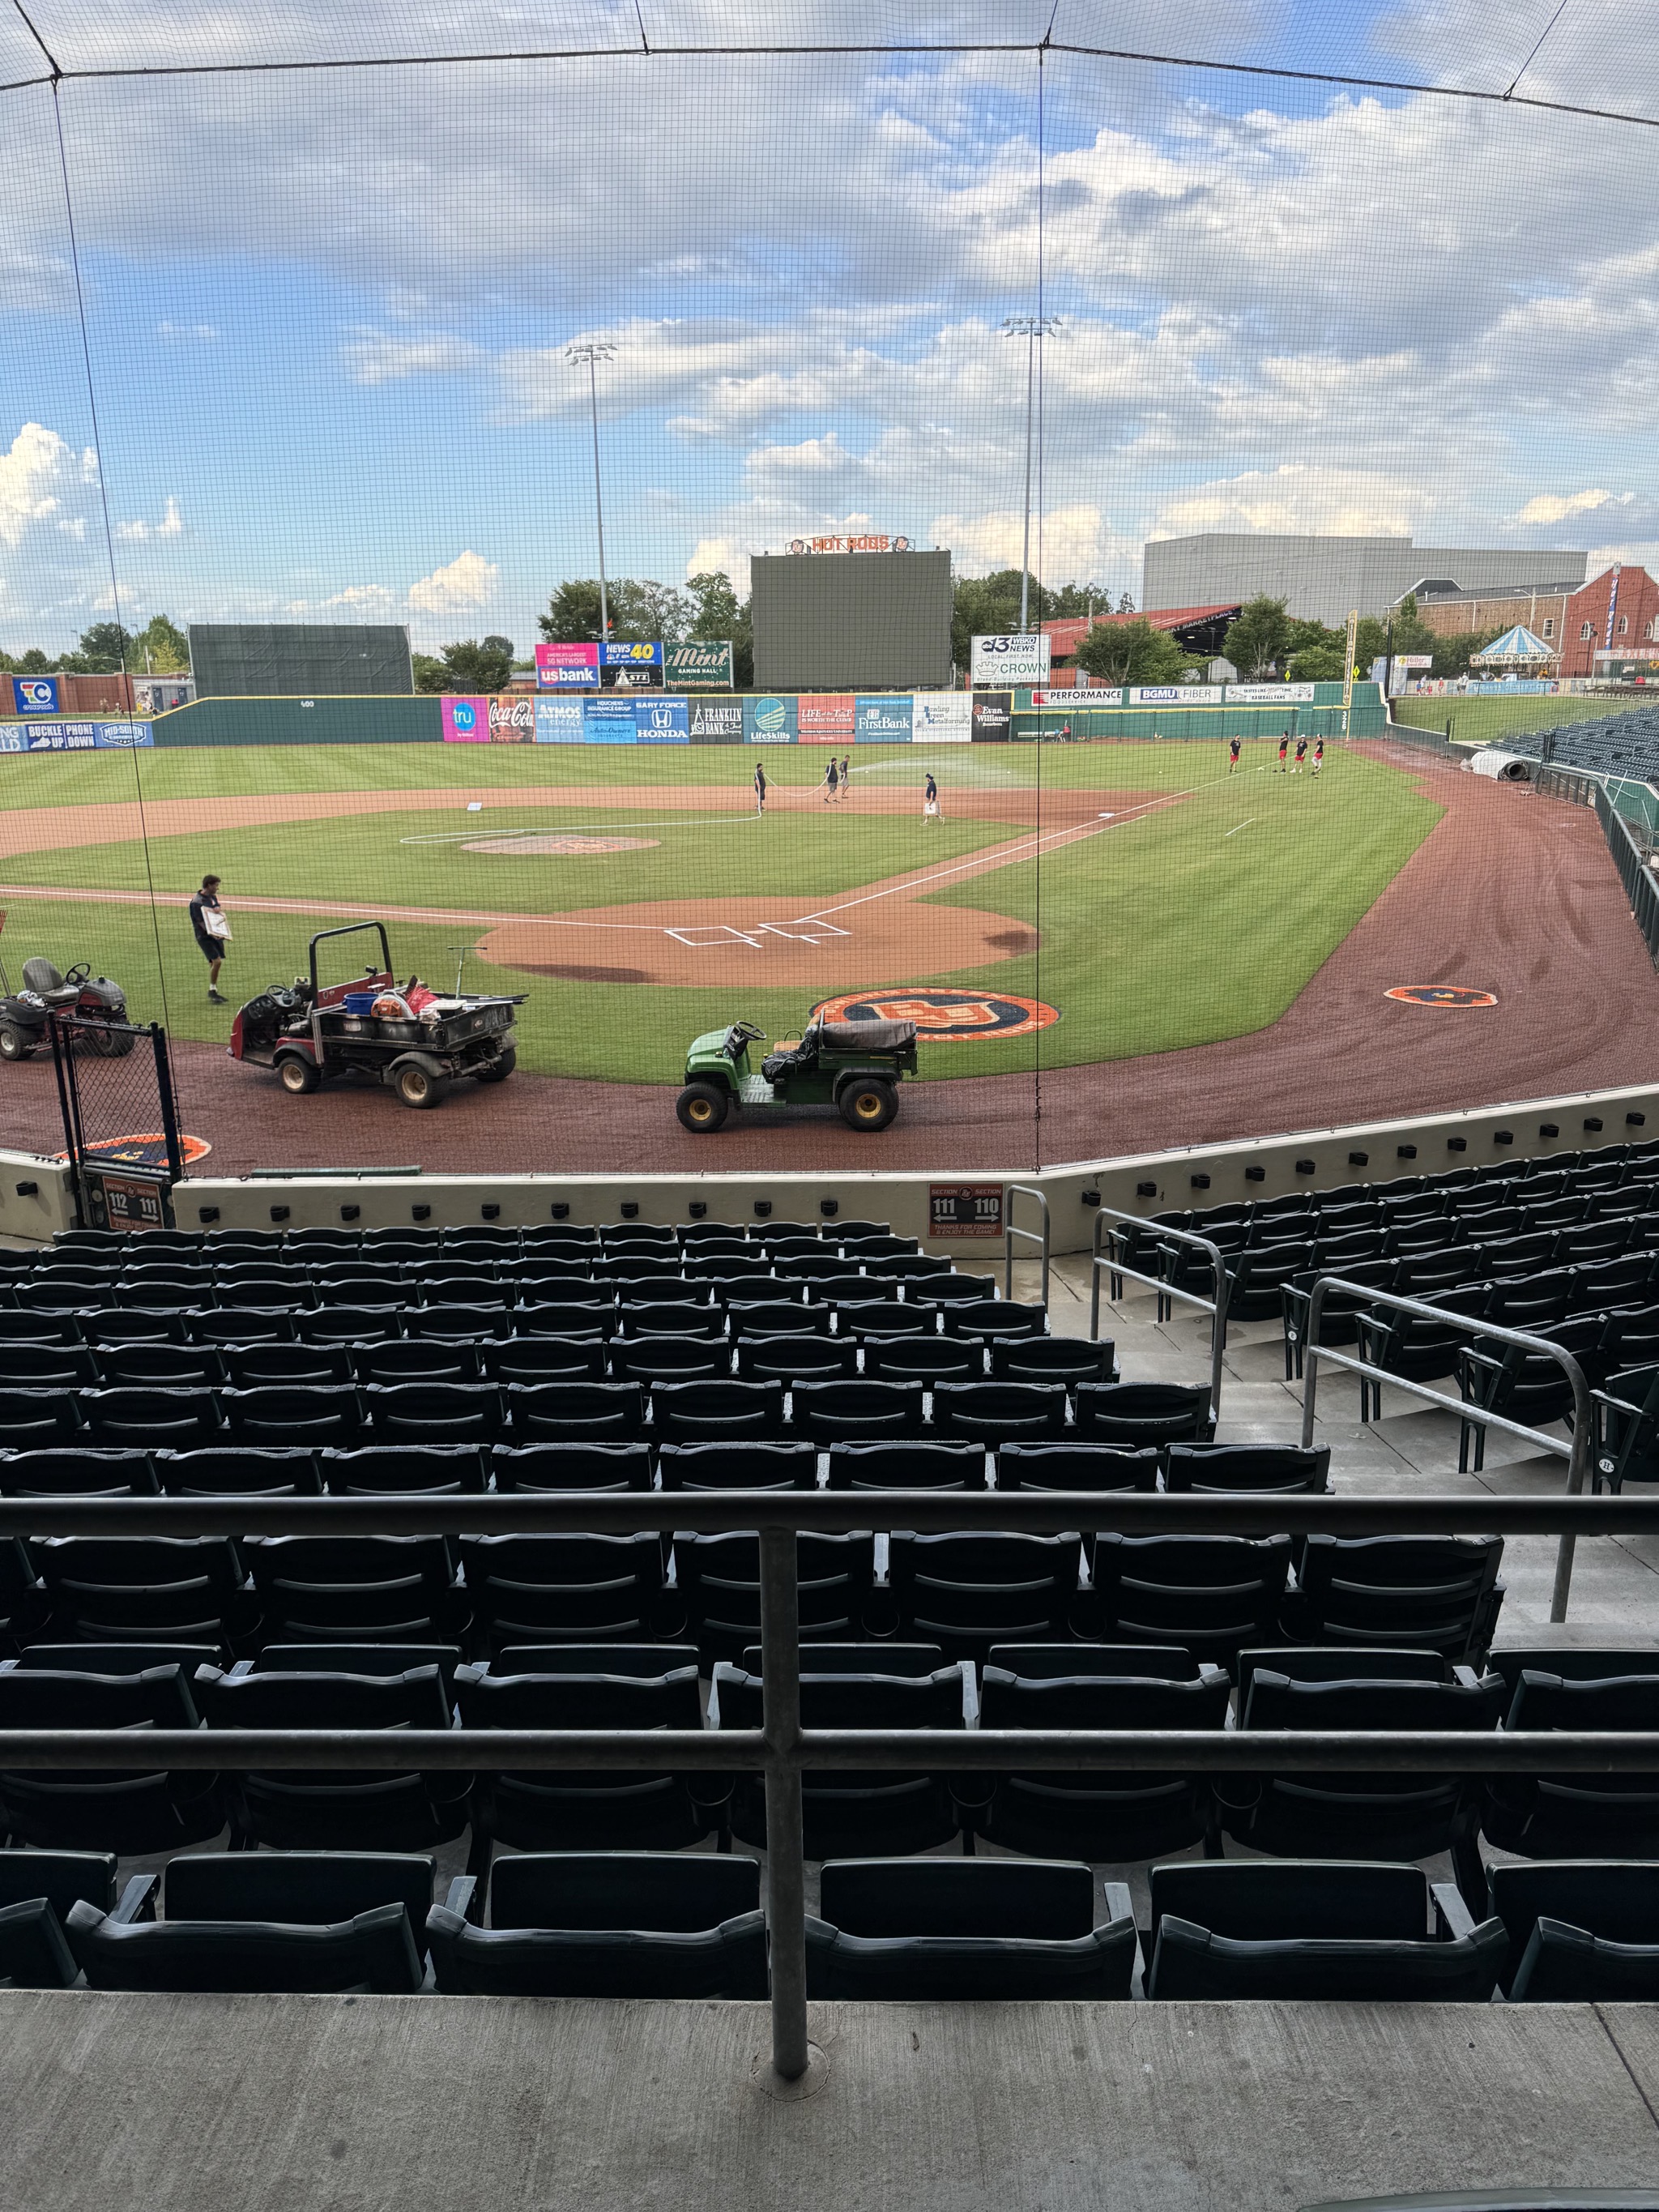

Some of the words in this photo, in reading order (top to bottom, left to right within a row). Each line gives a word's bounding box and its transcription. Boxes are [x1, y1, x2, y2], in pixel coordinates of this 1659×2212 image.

[812, 536, 843, 551] HOT
[847, 535, 889, 550] RODS
[606, 644, 631, 653] NEWS
[990, 637, 1011, 653] 13
[630, 643, 655, 660] 40
[672, 647, 729, 667] Mint
[1000, 663, 1047, 673] CROWN
[1050, 690, 1122, 699] PERFORMANCE
[1142, 689, 1175, 699] BGMU
[1183, 689, 1211, 698] FIBER
[488, 702, 535, 728] Coca-Cola
[704, 708, 742, 721] FRANKLIN
[801, 709, 821, 718] LIFE
[983, 706, 1003, 714] Evan
[453, 709, 471, 723] tru
[977, 714, 1009, 722] Williams
[705, 722, 724, 734] BANK
[859, 717, 911, 729] FirstBank
[28, 724, 63, 737] BUCKLE
[66, 724, 94, 735] PHONE
[104, 725, 144, 738] MID-SOUTH
[637, 729, 689, 738] HONDA
[67, 736, 95, 747] DOWN
[750, 732, 791, 740] LifeSkills
[51, 737, 64, 748] UP
[136, 1188, 157, 1196] SECTION
[109, 1192, 128, 1209] 112
[139, 1198, 157, 1214] 111
[932, 1198, 955, 1214] 111
[974, 1198, 1000, 1214] 110
[1603, 1461, 1610, 1471] H
